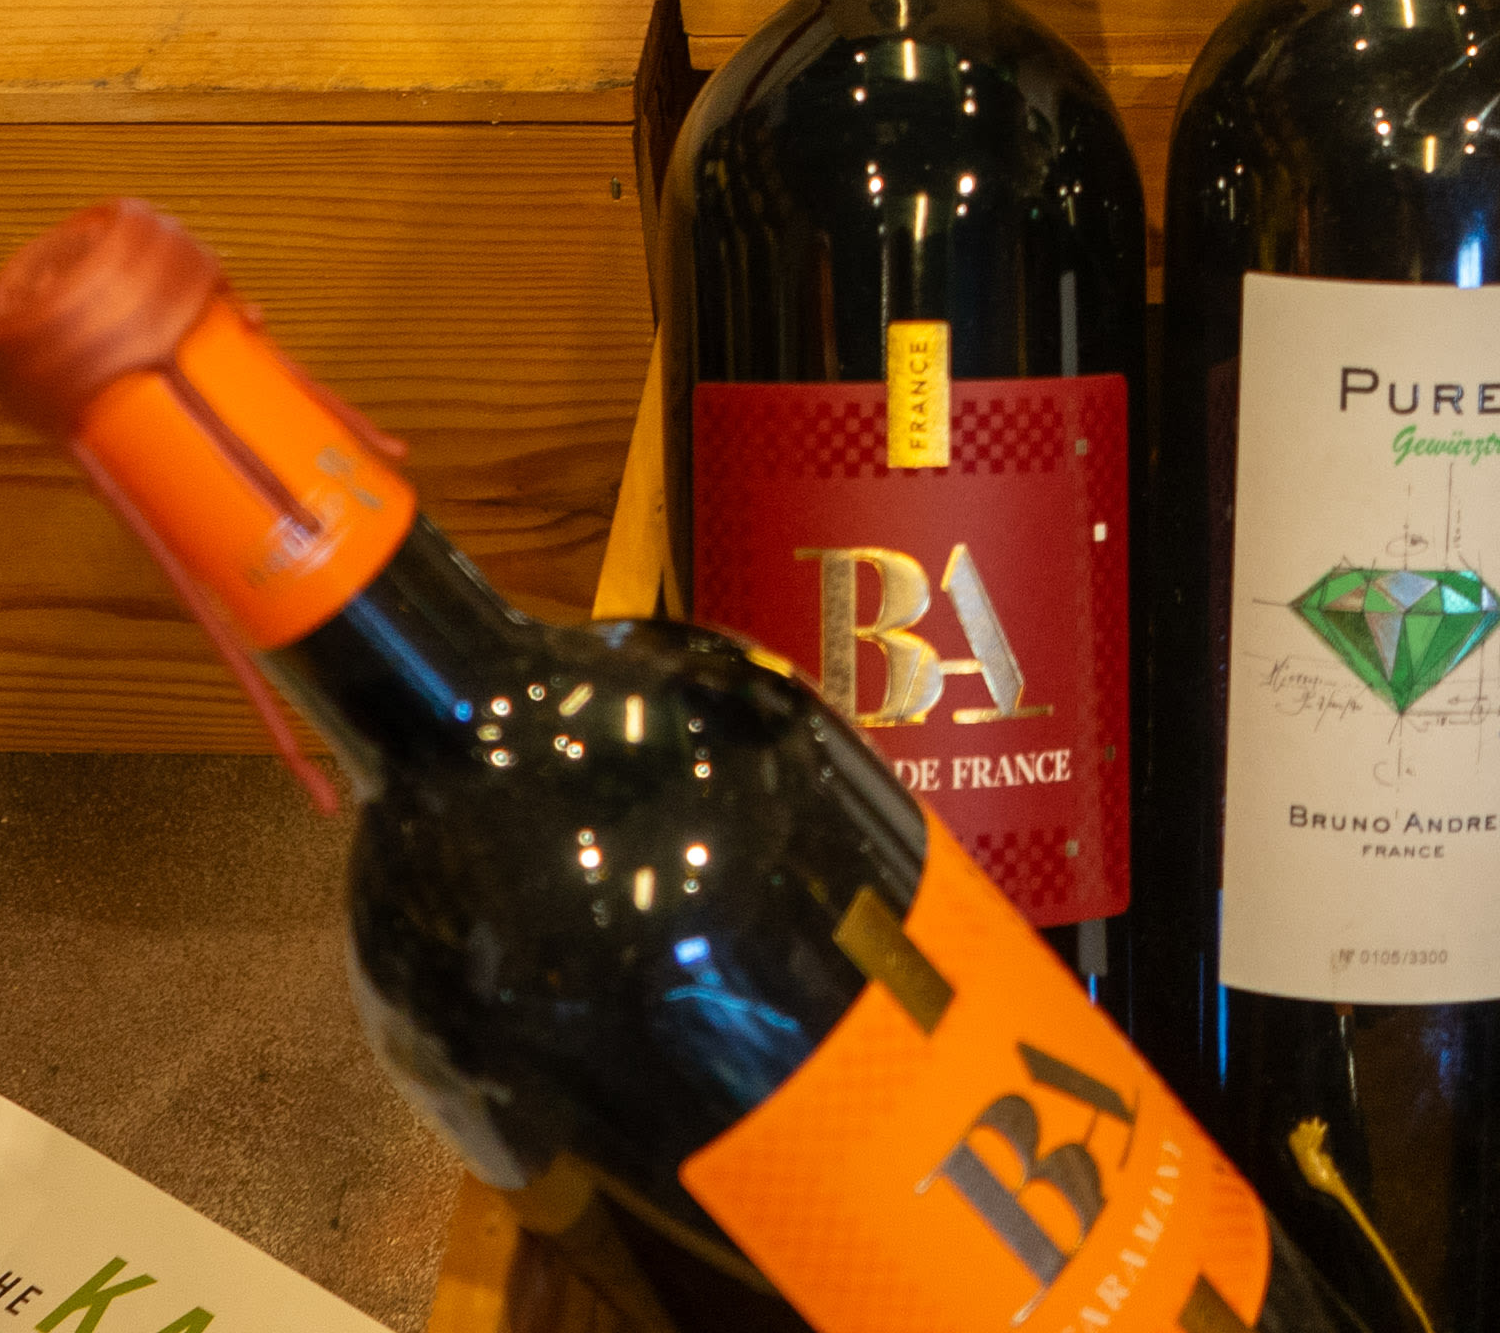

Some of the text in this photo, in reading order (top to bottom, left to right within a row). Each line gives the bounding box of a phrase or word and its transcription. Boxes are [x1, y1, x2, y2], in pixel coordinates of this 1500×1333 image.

[909, 340, 931, 451] FRANCE
[794, 541, 1055, 728] BA
[952, 748, 1073, 789] FRANCE
[1289, 805, 1391, 833] BRUNO
[1362, 844, 1445, 860] FRANCE
